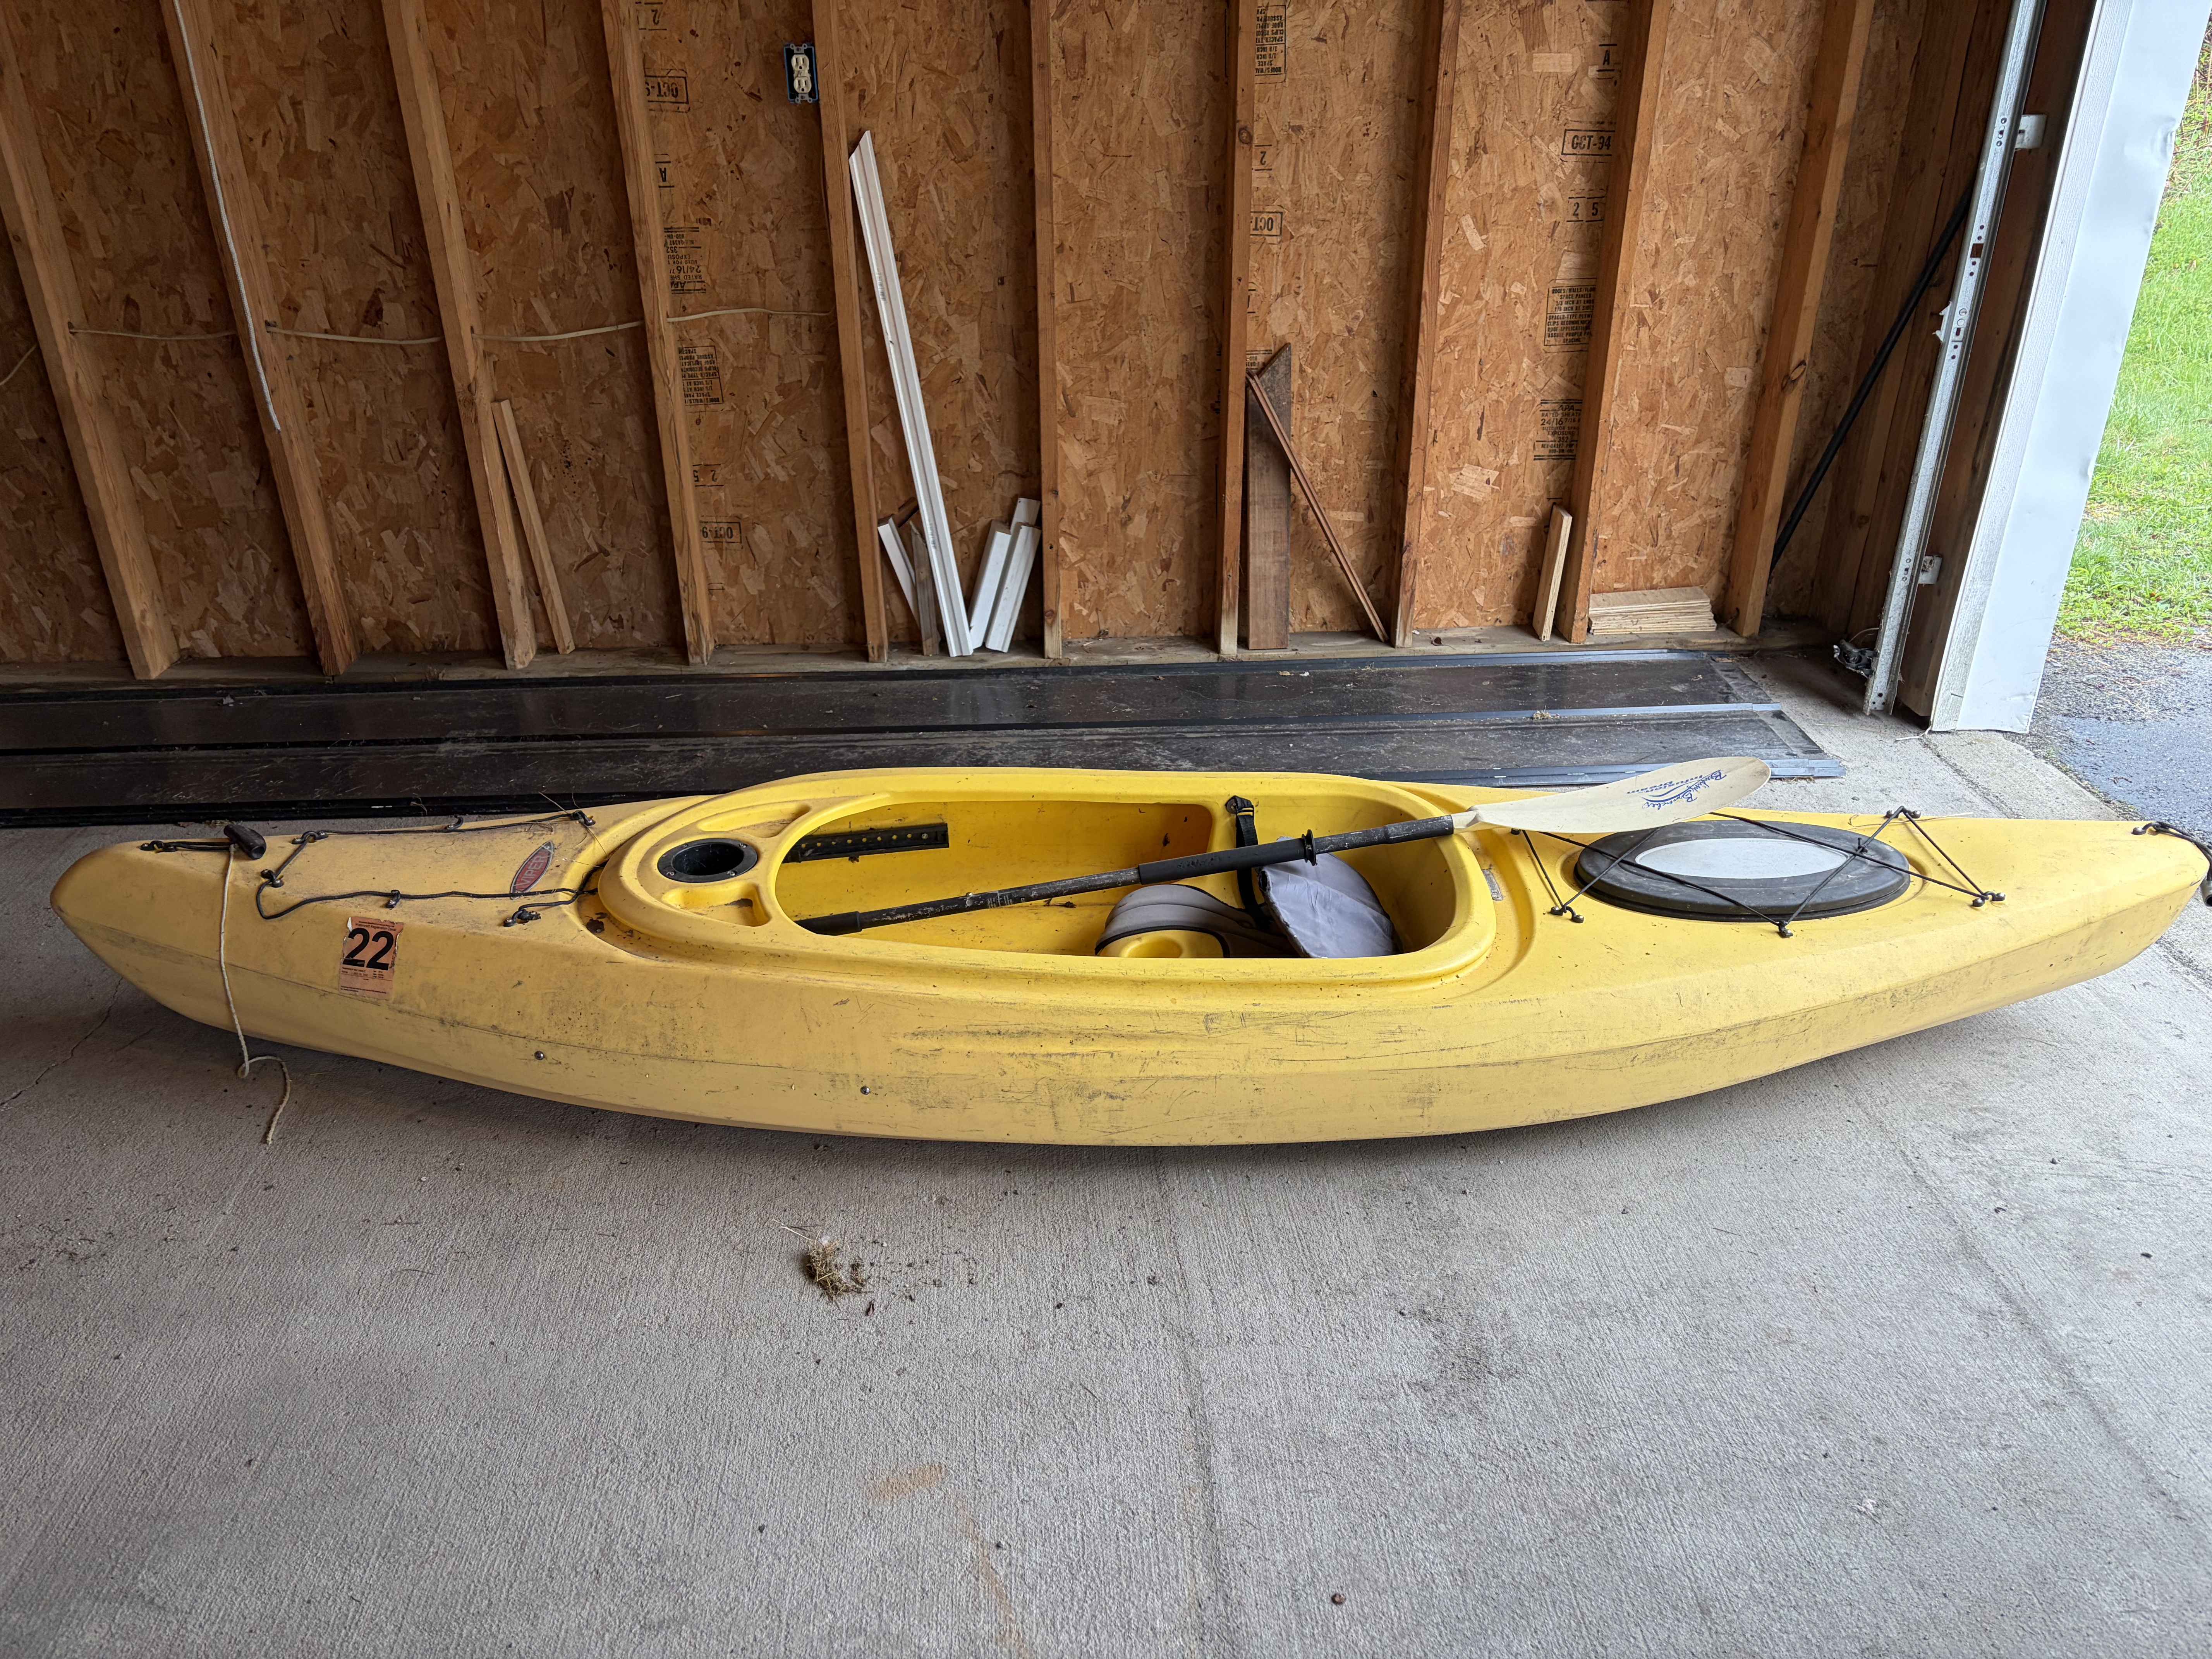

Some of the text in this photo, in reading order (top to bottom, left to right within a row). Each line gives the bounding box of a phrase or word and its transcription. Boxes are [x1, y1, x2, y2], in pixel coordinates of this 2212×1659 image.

[651, 9, 659, 25] 2
[1602, 50, 1610, 65] A
[1571, 134, 1611, 150] OCT-94
[1260, 151, 1266, 165] 2
[659, 167, 667, 182] A
[1572, 202, 1599, 216] 2 5
[676, 265, 701, 273] 24/16
[1540, 418, 1563, 426] 24/16
[711, 469, 718, 483] 2
[514, 855, 551, 887] VIPER
[342, 927, 394, 971] 22
